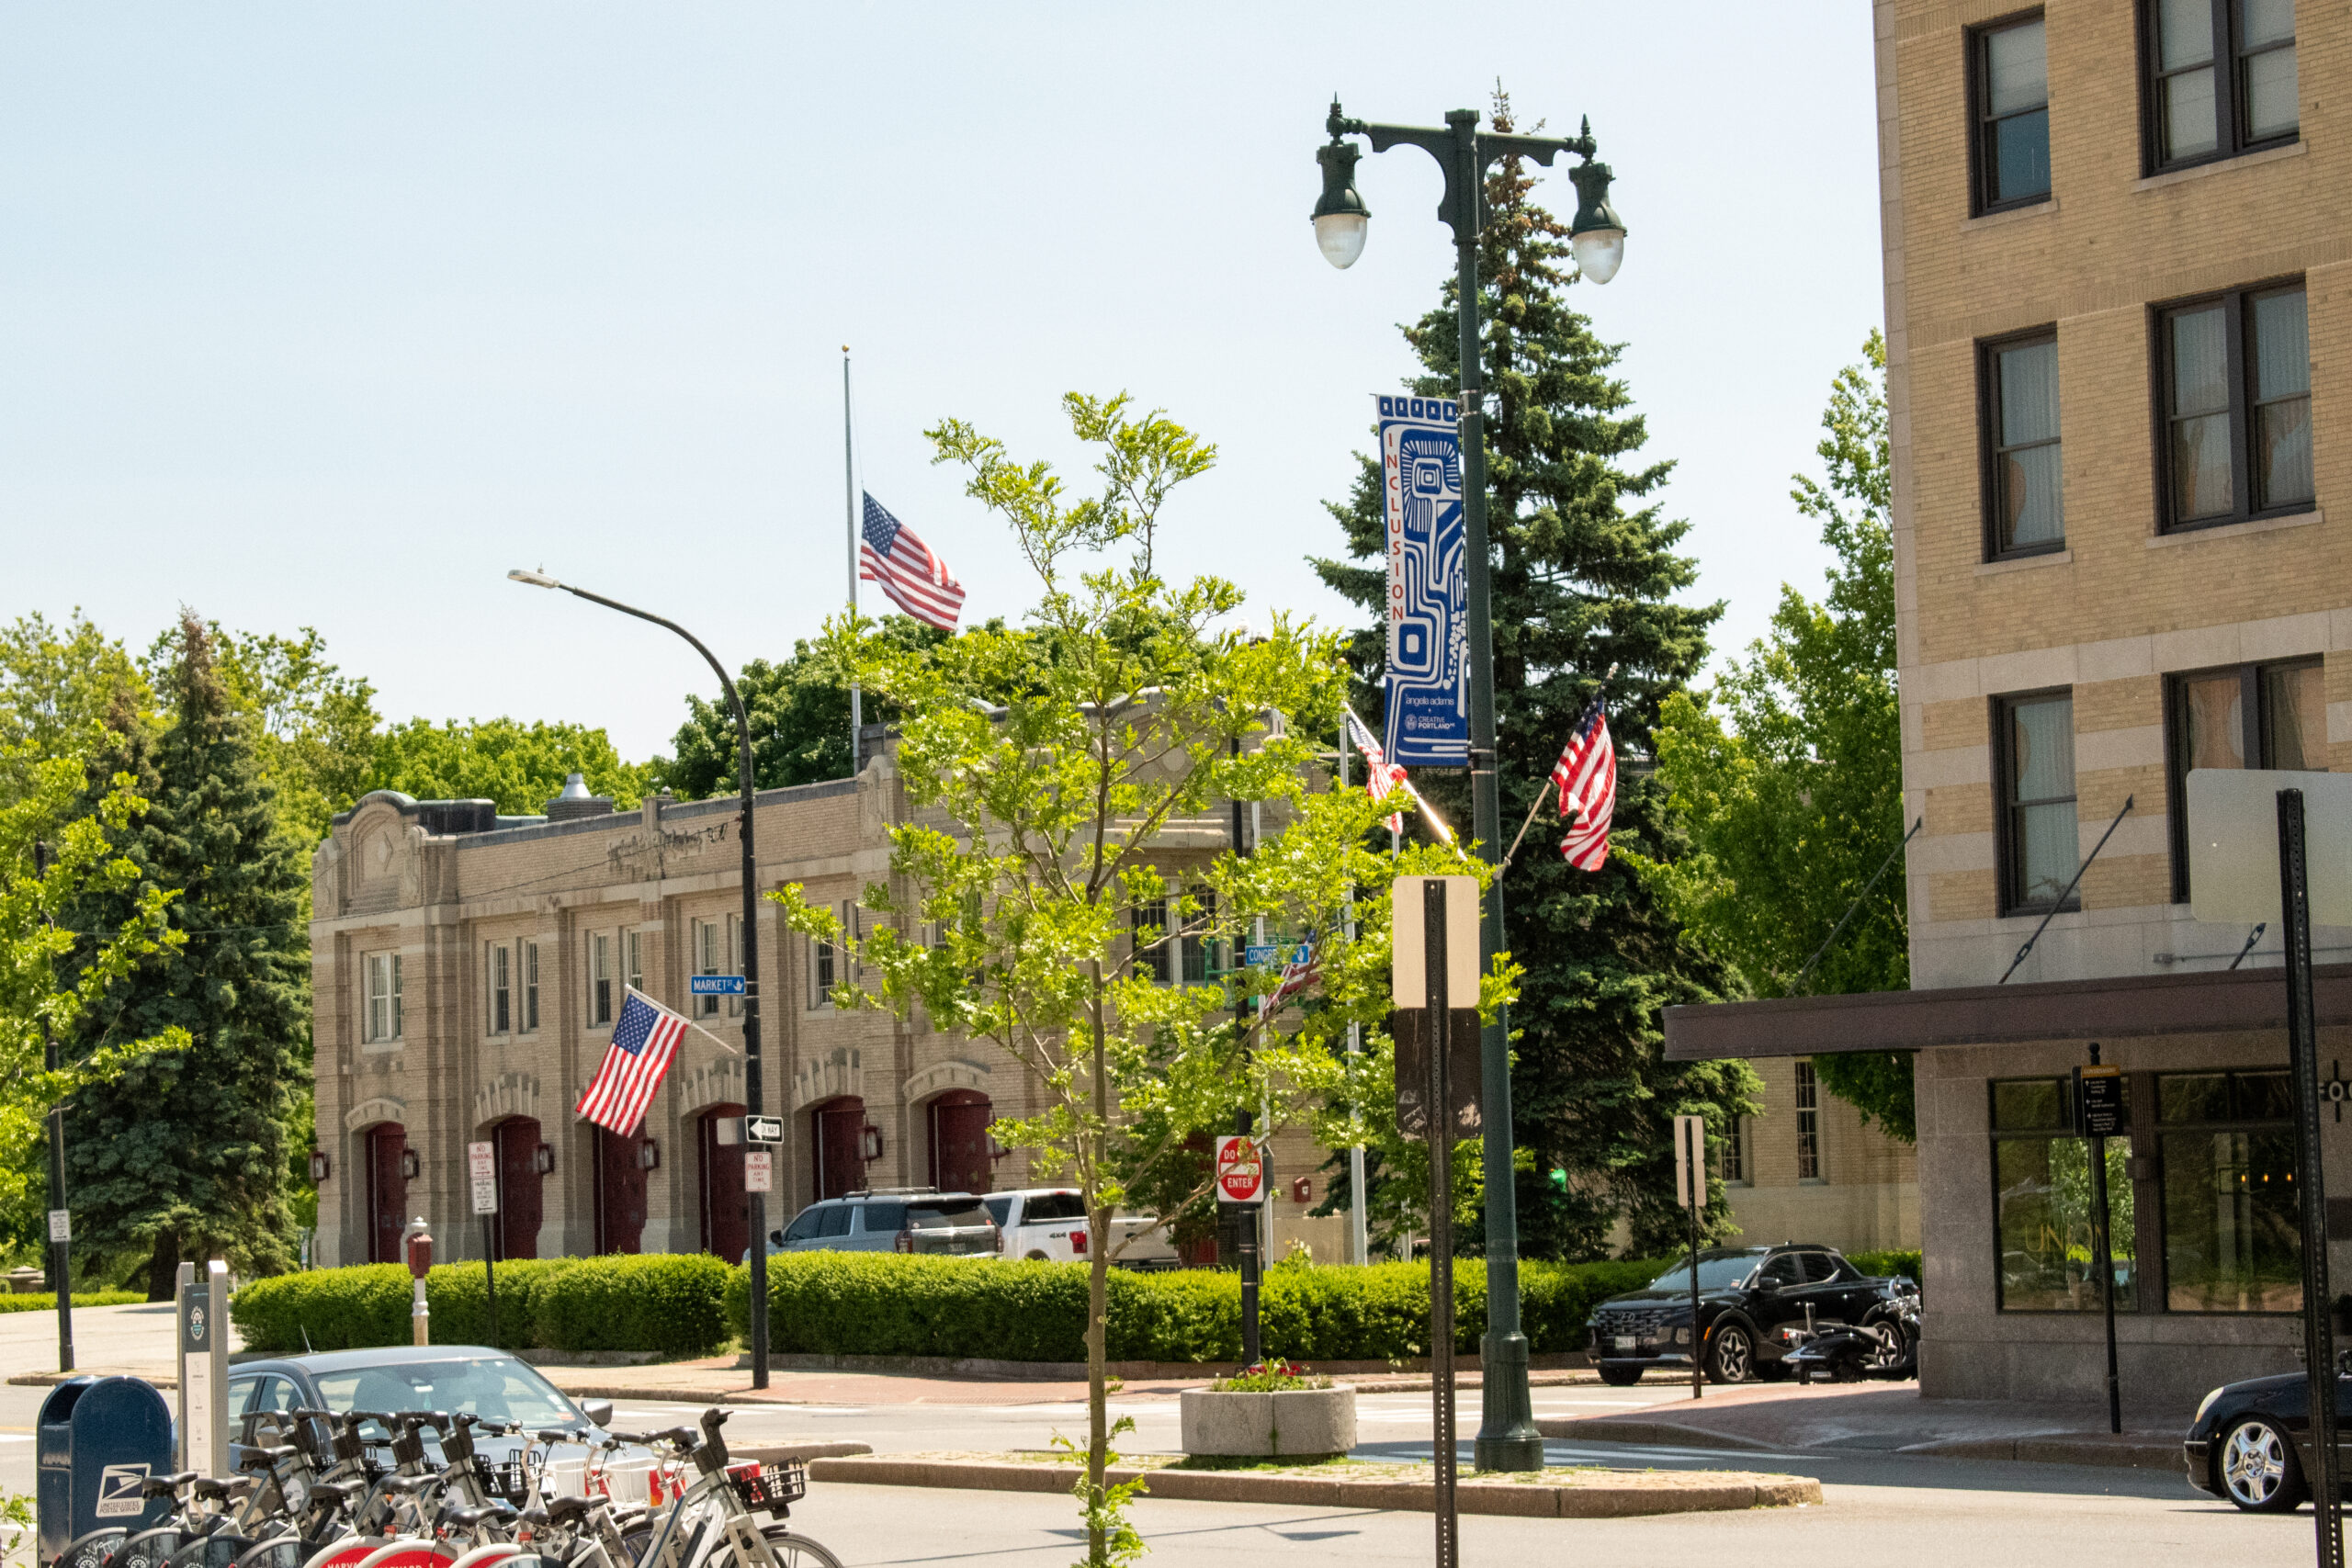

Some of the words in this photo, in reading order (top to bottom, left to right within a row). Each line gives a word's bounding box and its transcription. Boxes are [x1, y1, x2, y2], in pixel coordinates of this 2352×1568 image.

[1386, 433, 1404, 621] INCLUSION
[1405, 696, 1429, 706] angela
[1430, 695, 1454, 705] adams
[1249, 948, 1283, 962] CONGRE
[694, 979, 727, 991] MARKET
[753, 1154, 763, 1162] NO
[1224, 1149, 1236, 1160] DO
[1227, 1177, 1253, 1189] ENTER
